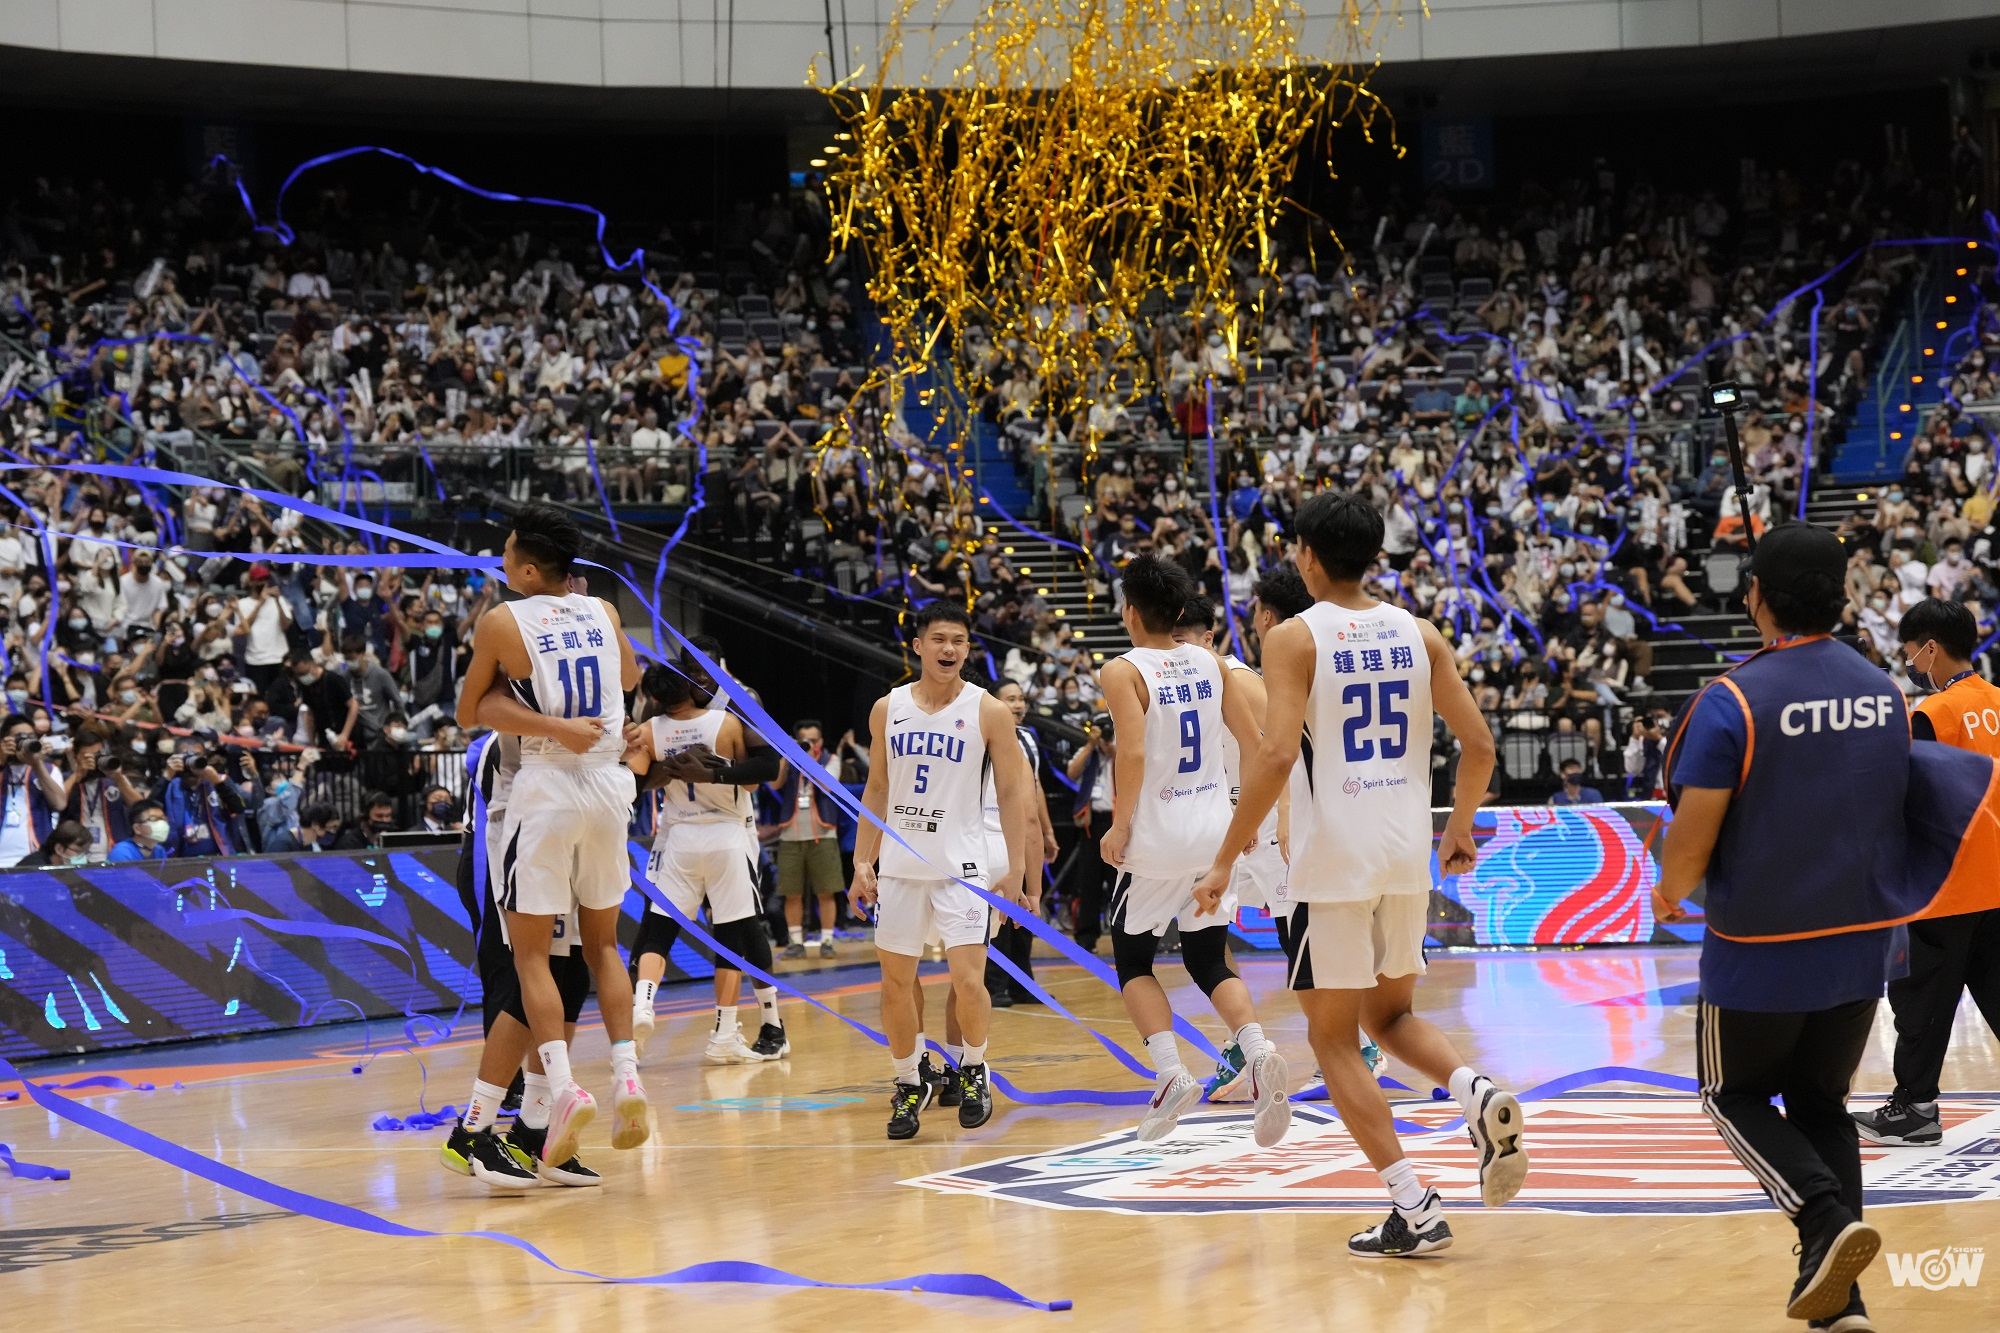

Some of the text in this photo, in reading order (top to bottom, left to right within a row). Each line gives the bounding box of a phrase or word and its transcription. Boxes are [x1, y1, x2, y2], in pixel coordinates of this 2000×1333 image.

[1430, 159, 1485, 185] 2D
[537, 628, 604, 654] 王凱裕
[1333, 646, 1414, 674] 鍾理翔
[557, 655, 602, 719] 10
[1342, 679, 1410, 763] 25
[1780, 695, 1894, 737] CTUSF
[890, 731, 966, 763] NCCU
[1177, 709, 1201, 774] 9
[914, 764, 930, 794] 5
[1174, 789, 1193, 798] Spirit
[1363, 779, 1384, 790] Spirit
[894, 805, 946, 819] SOLE
